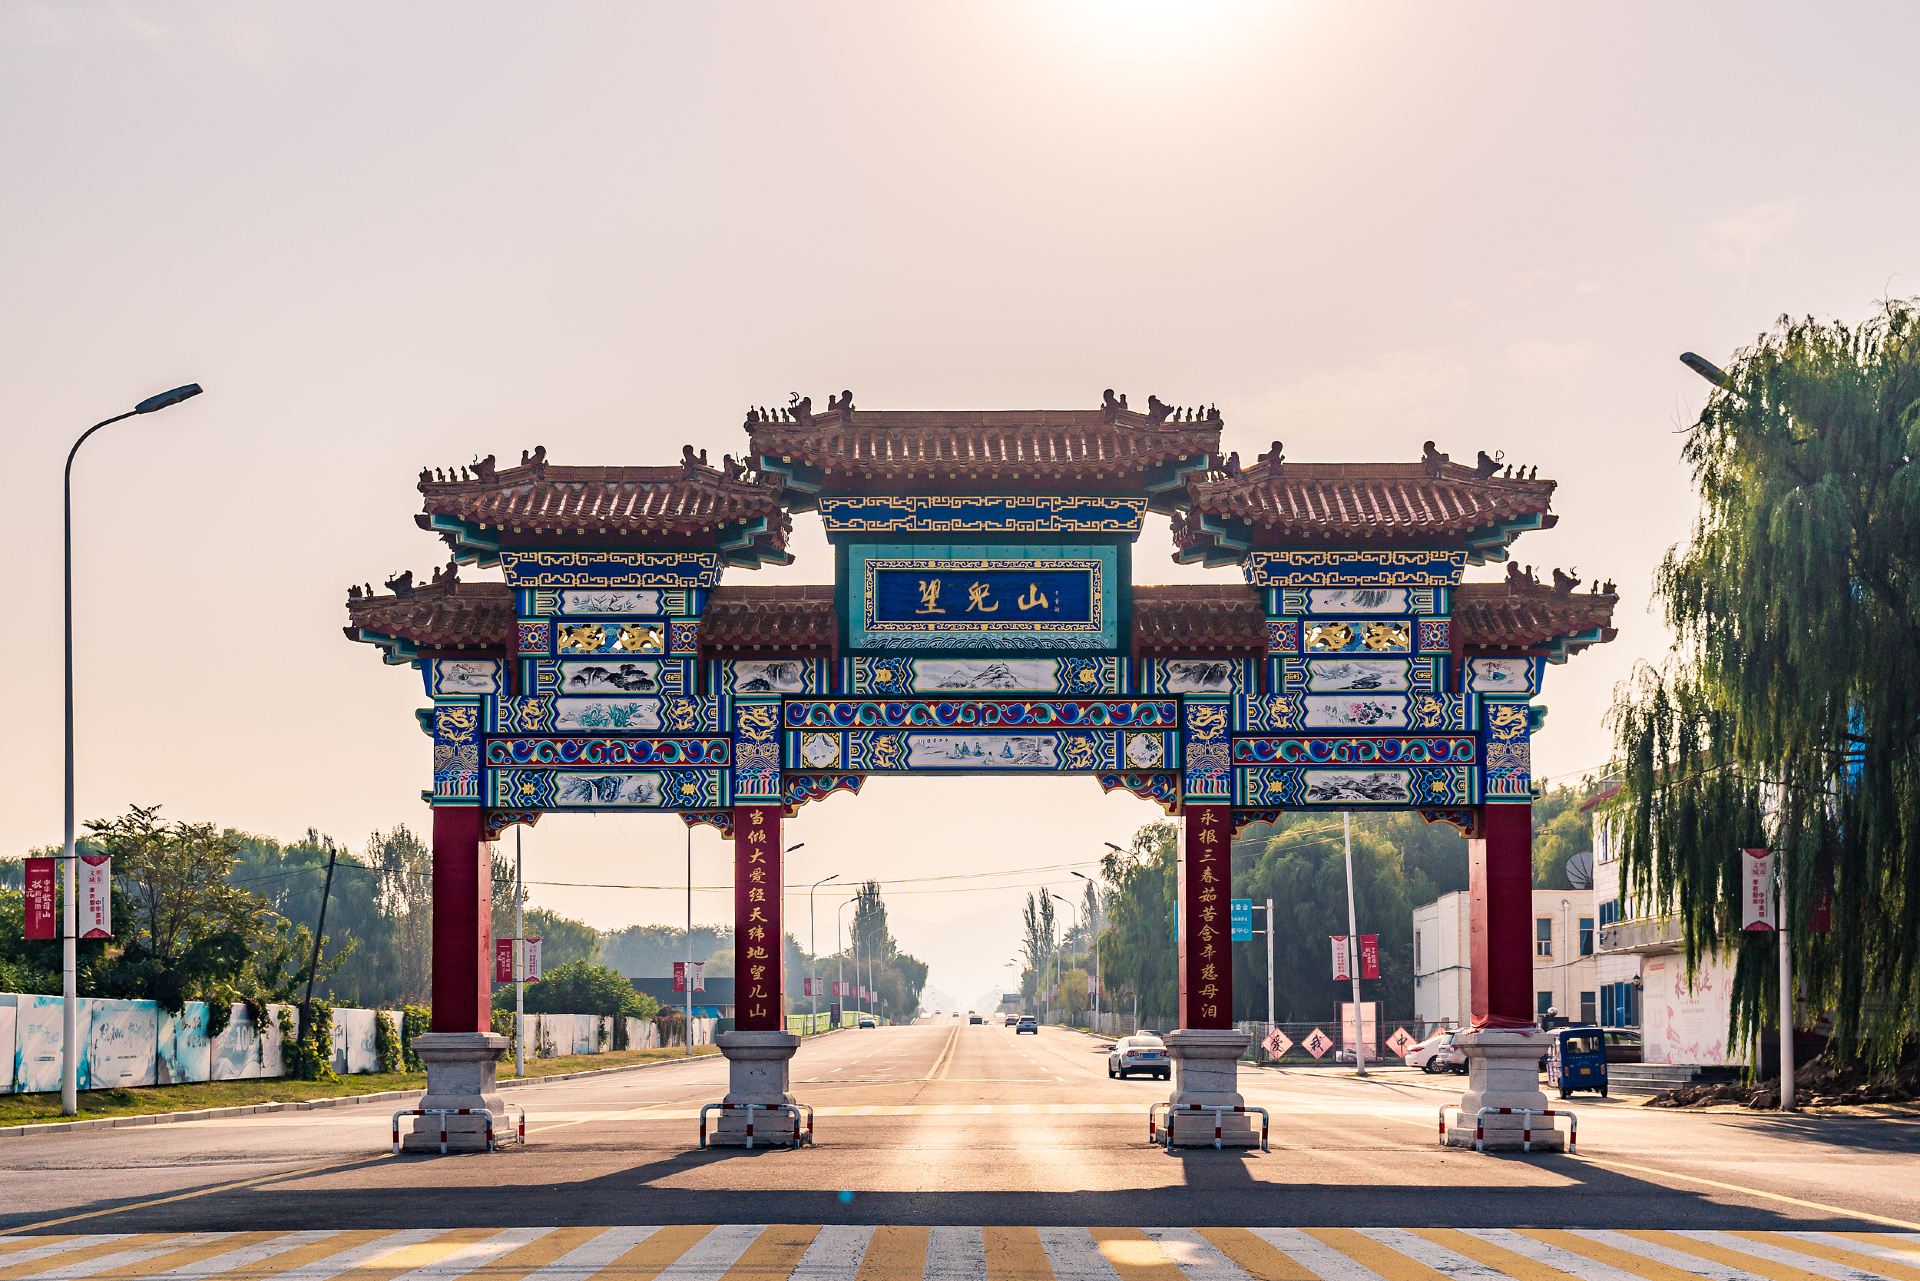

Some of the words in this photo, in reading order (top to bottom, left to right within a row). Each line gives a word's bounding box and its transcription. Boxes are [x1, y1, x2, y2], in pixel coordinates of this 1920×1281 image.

[1196, 808, 1221, 1018] 永报三春茹苦含辛慈母泪
[1396, 1033, 1408, 1054] 中
